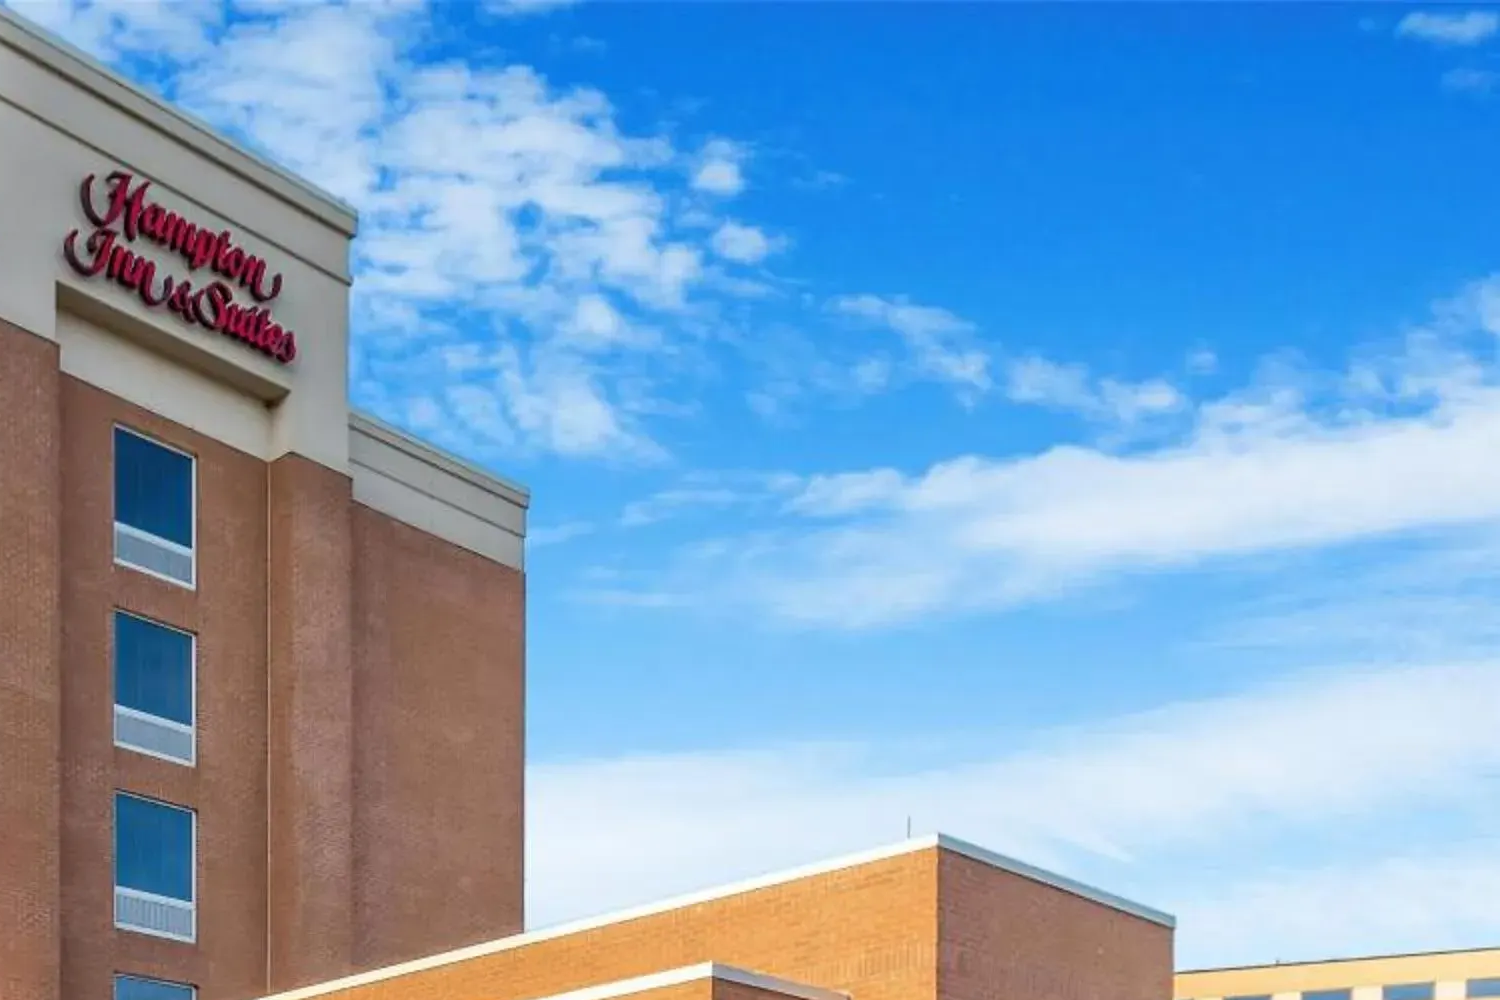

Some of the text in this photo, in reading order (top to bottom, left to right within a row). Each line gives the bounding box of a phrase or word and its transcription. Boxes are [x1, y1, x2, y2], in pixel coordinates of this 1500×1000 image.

[63, 229, 296, 363] Inn & Suites
[80, 170, 282, 302] Hampton
